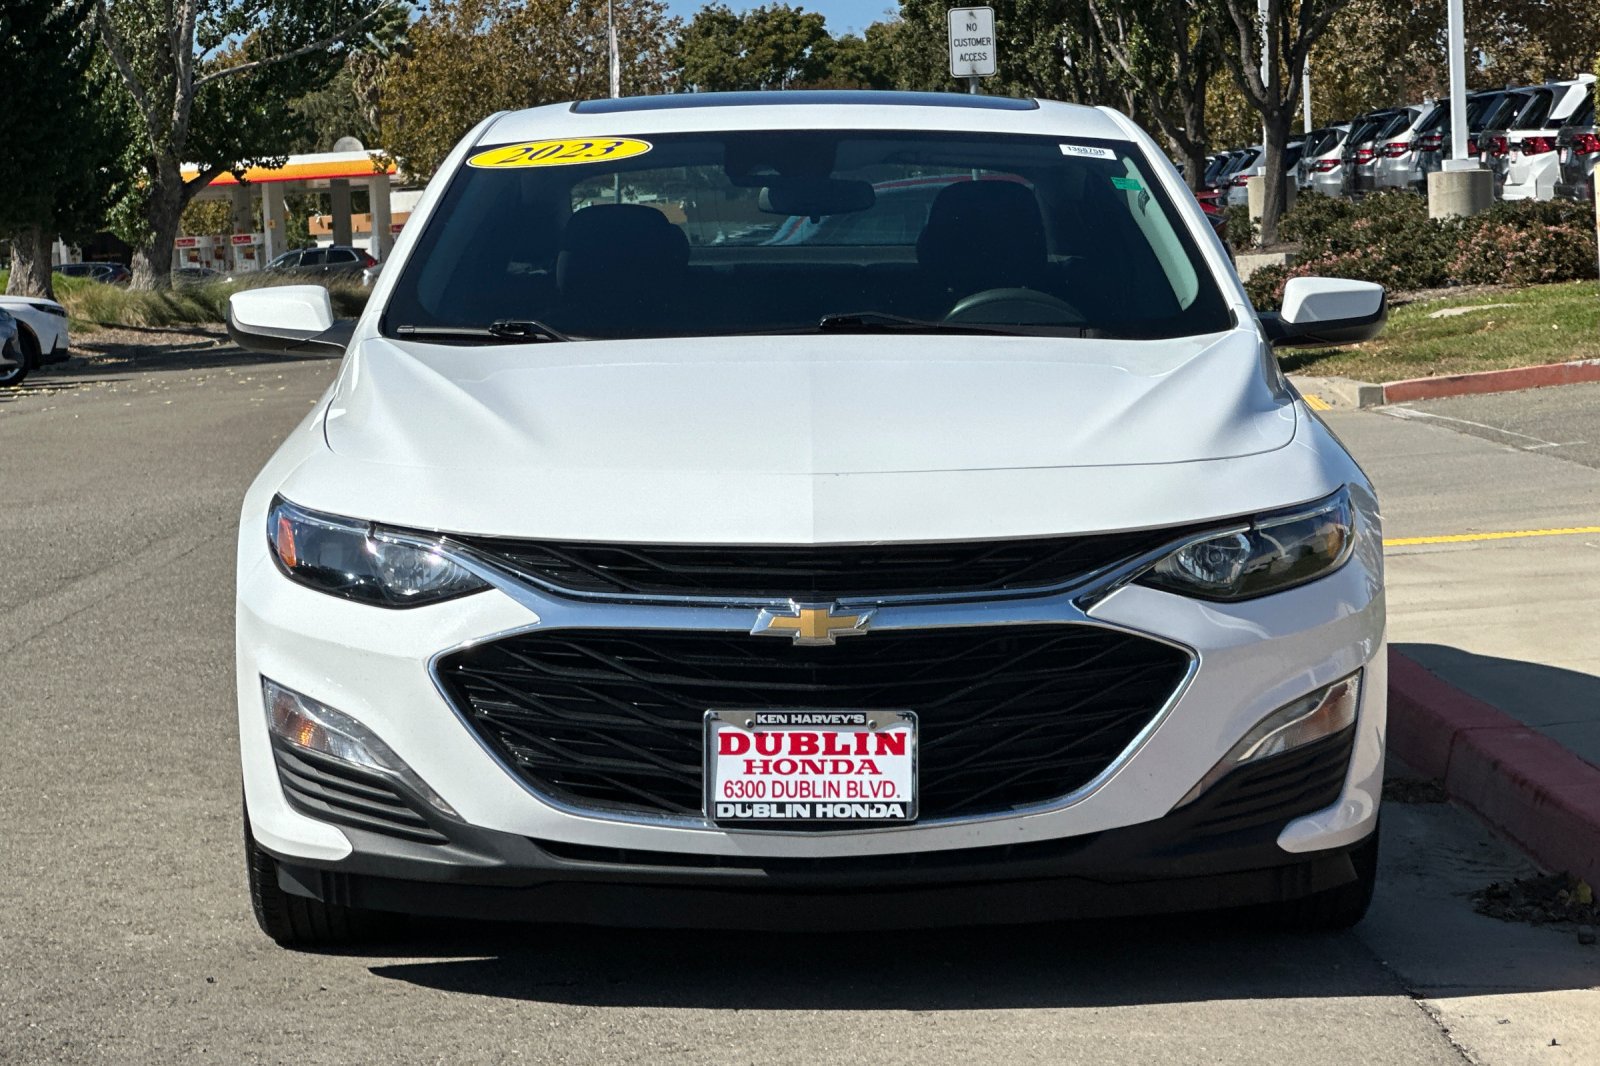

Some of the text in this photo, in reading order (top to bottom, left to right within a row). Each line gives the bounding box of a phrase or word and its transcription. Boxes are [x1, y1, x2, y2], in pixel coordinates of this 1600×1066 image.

[966, 23, 977, 32] NO
[953, 37, 992, 47] CUSTOMER
[959, 52, 987, 62] ACCESS
[494, 141, 625, 165] 2023
[757, 714, 865, 724] KEN HARVEY'S
[718, 732, 906, 756] DUBLIN
[743, 759, 882, 776] HONDA
[724, 780, 901, 799] 6300 DUBLIN BLVD.
[716, 803, 905, 818] DUBLIN HONDA
